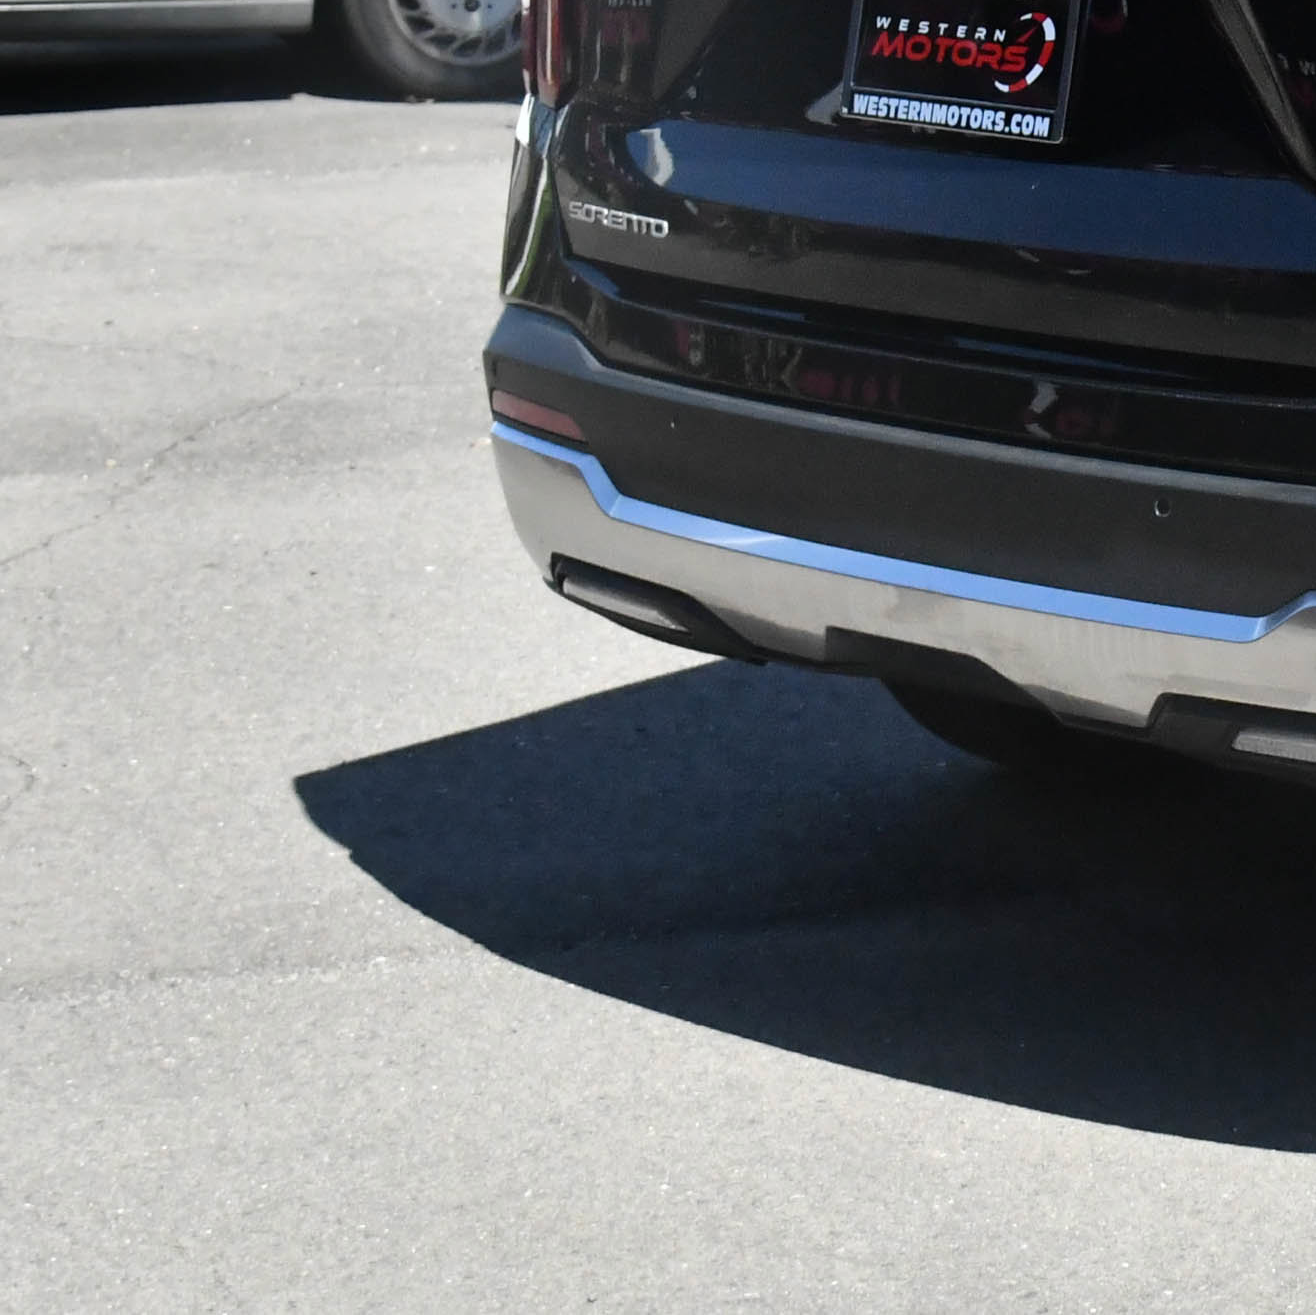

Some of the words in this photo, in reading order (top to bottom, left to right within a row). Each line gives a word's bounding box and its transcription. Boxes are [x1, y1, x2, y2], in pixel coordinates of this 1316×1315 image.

[876, 16, 1007, 42] WESTERN
[871, 32, 1030, 73] MOTORS
[852, 93, 1051, 137] WESTERNMOTORS.COM
[568, 201, 669, 238] SORENTO
